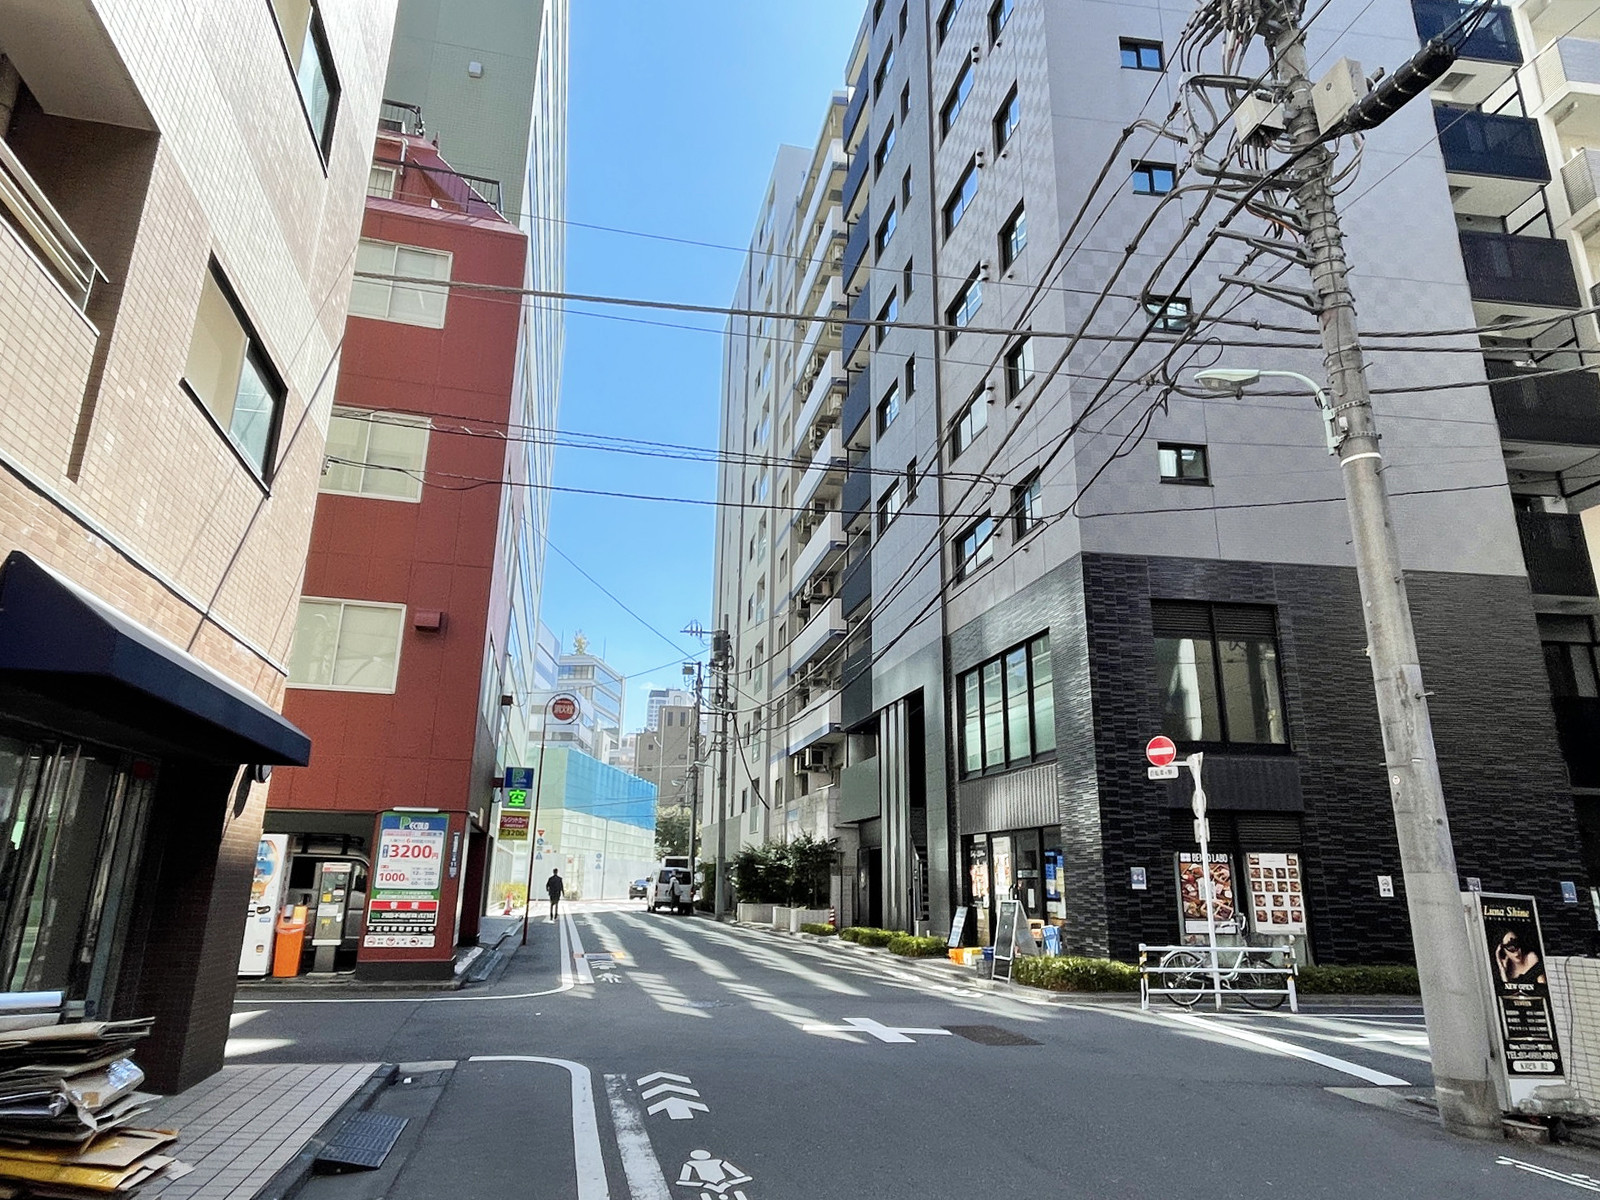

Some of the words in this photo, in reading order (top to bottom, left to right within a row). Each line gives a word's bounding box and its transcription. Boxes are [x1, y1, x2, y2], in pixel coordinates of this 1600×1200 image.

[508, 789, 527, 807] 空
[1191, 853, 1212, 863] BEO
[1506, 906, 1531, 918] Shine
[1504, 983, 1518, 991] NEW
